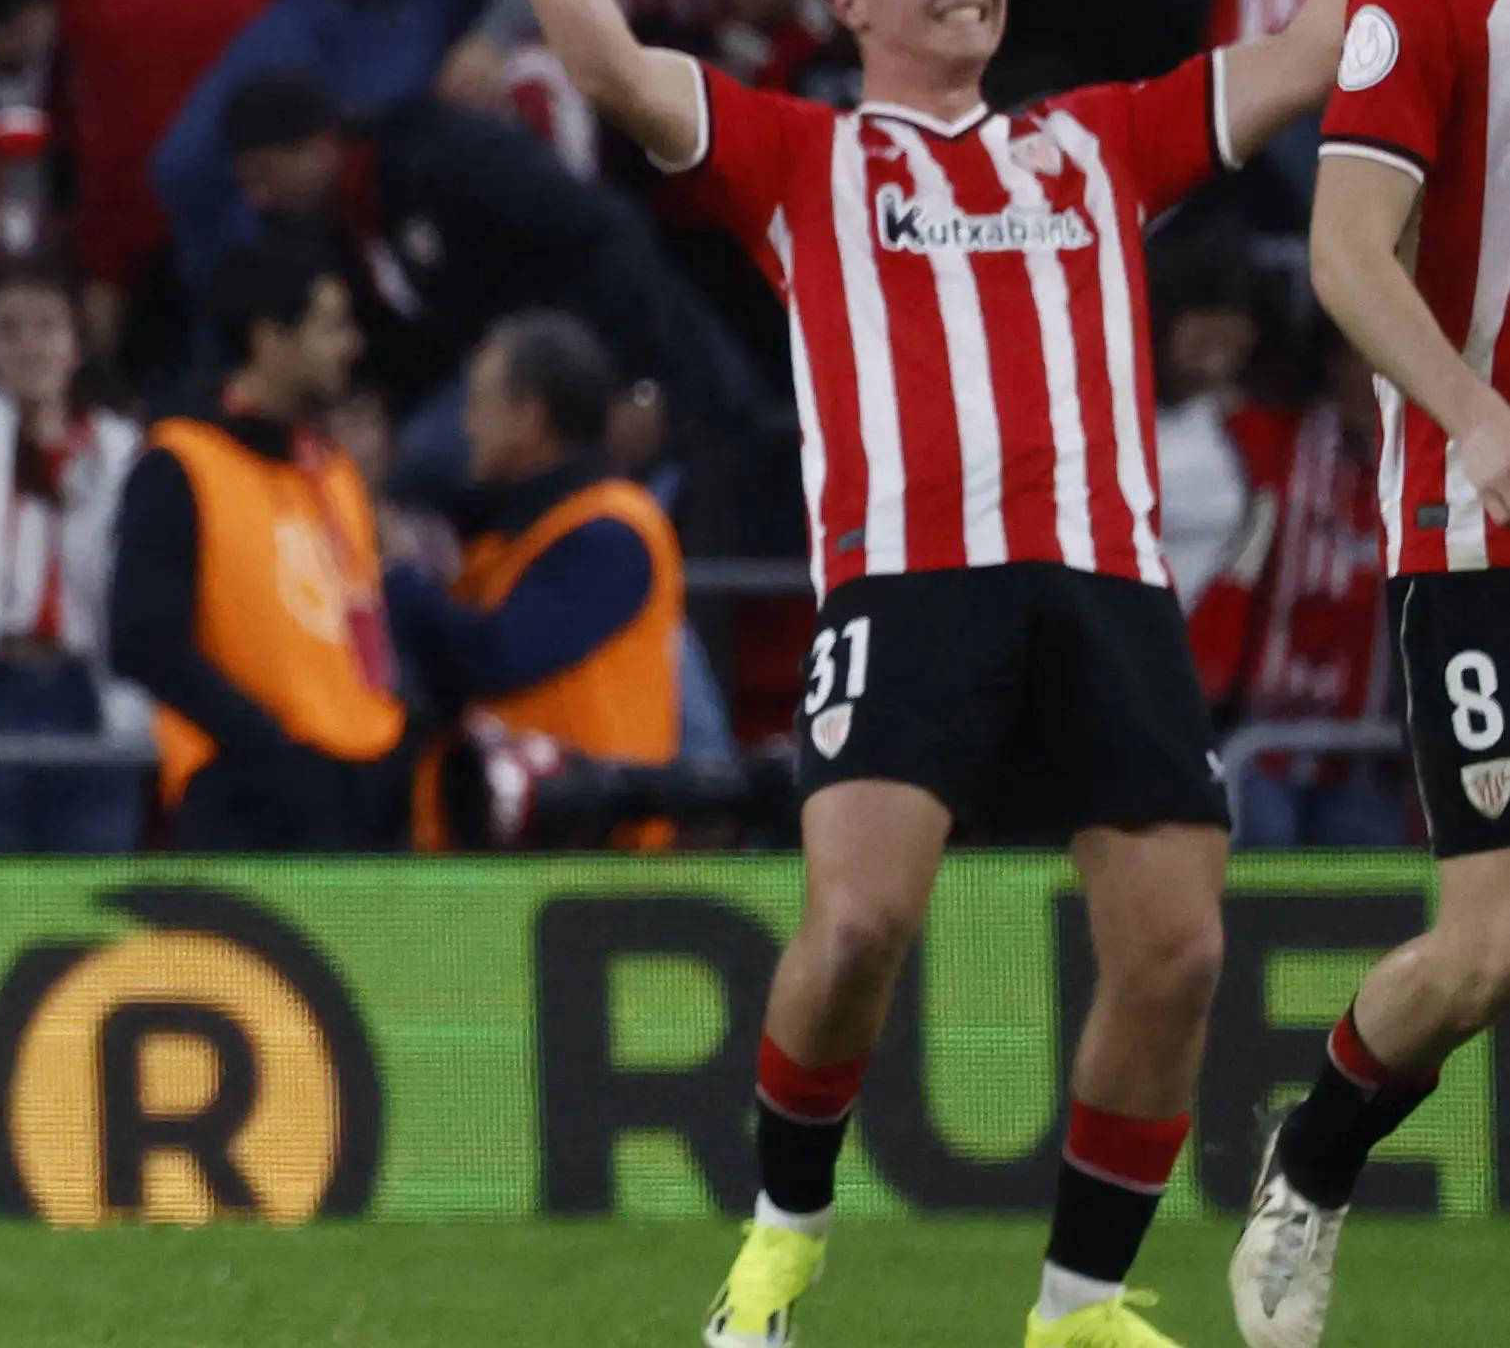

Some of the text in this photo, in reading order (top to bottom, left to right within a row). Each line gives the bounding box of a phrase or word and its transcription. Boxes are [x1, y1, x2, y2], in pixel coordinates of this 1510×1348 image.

[884, 192, 1089, 245] Kutxabank
[804, 617, 870, 715] 31
[1445, 649, 1504, 750] 8
